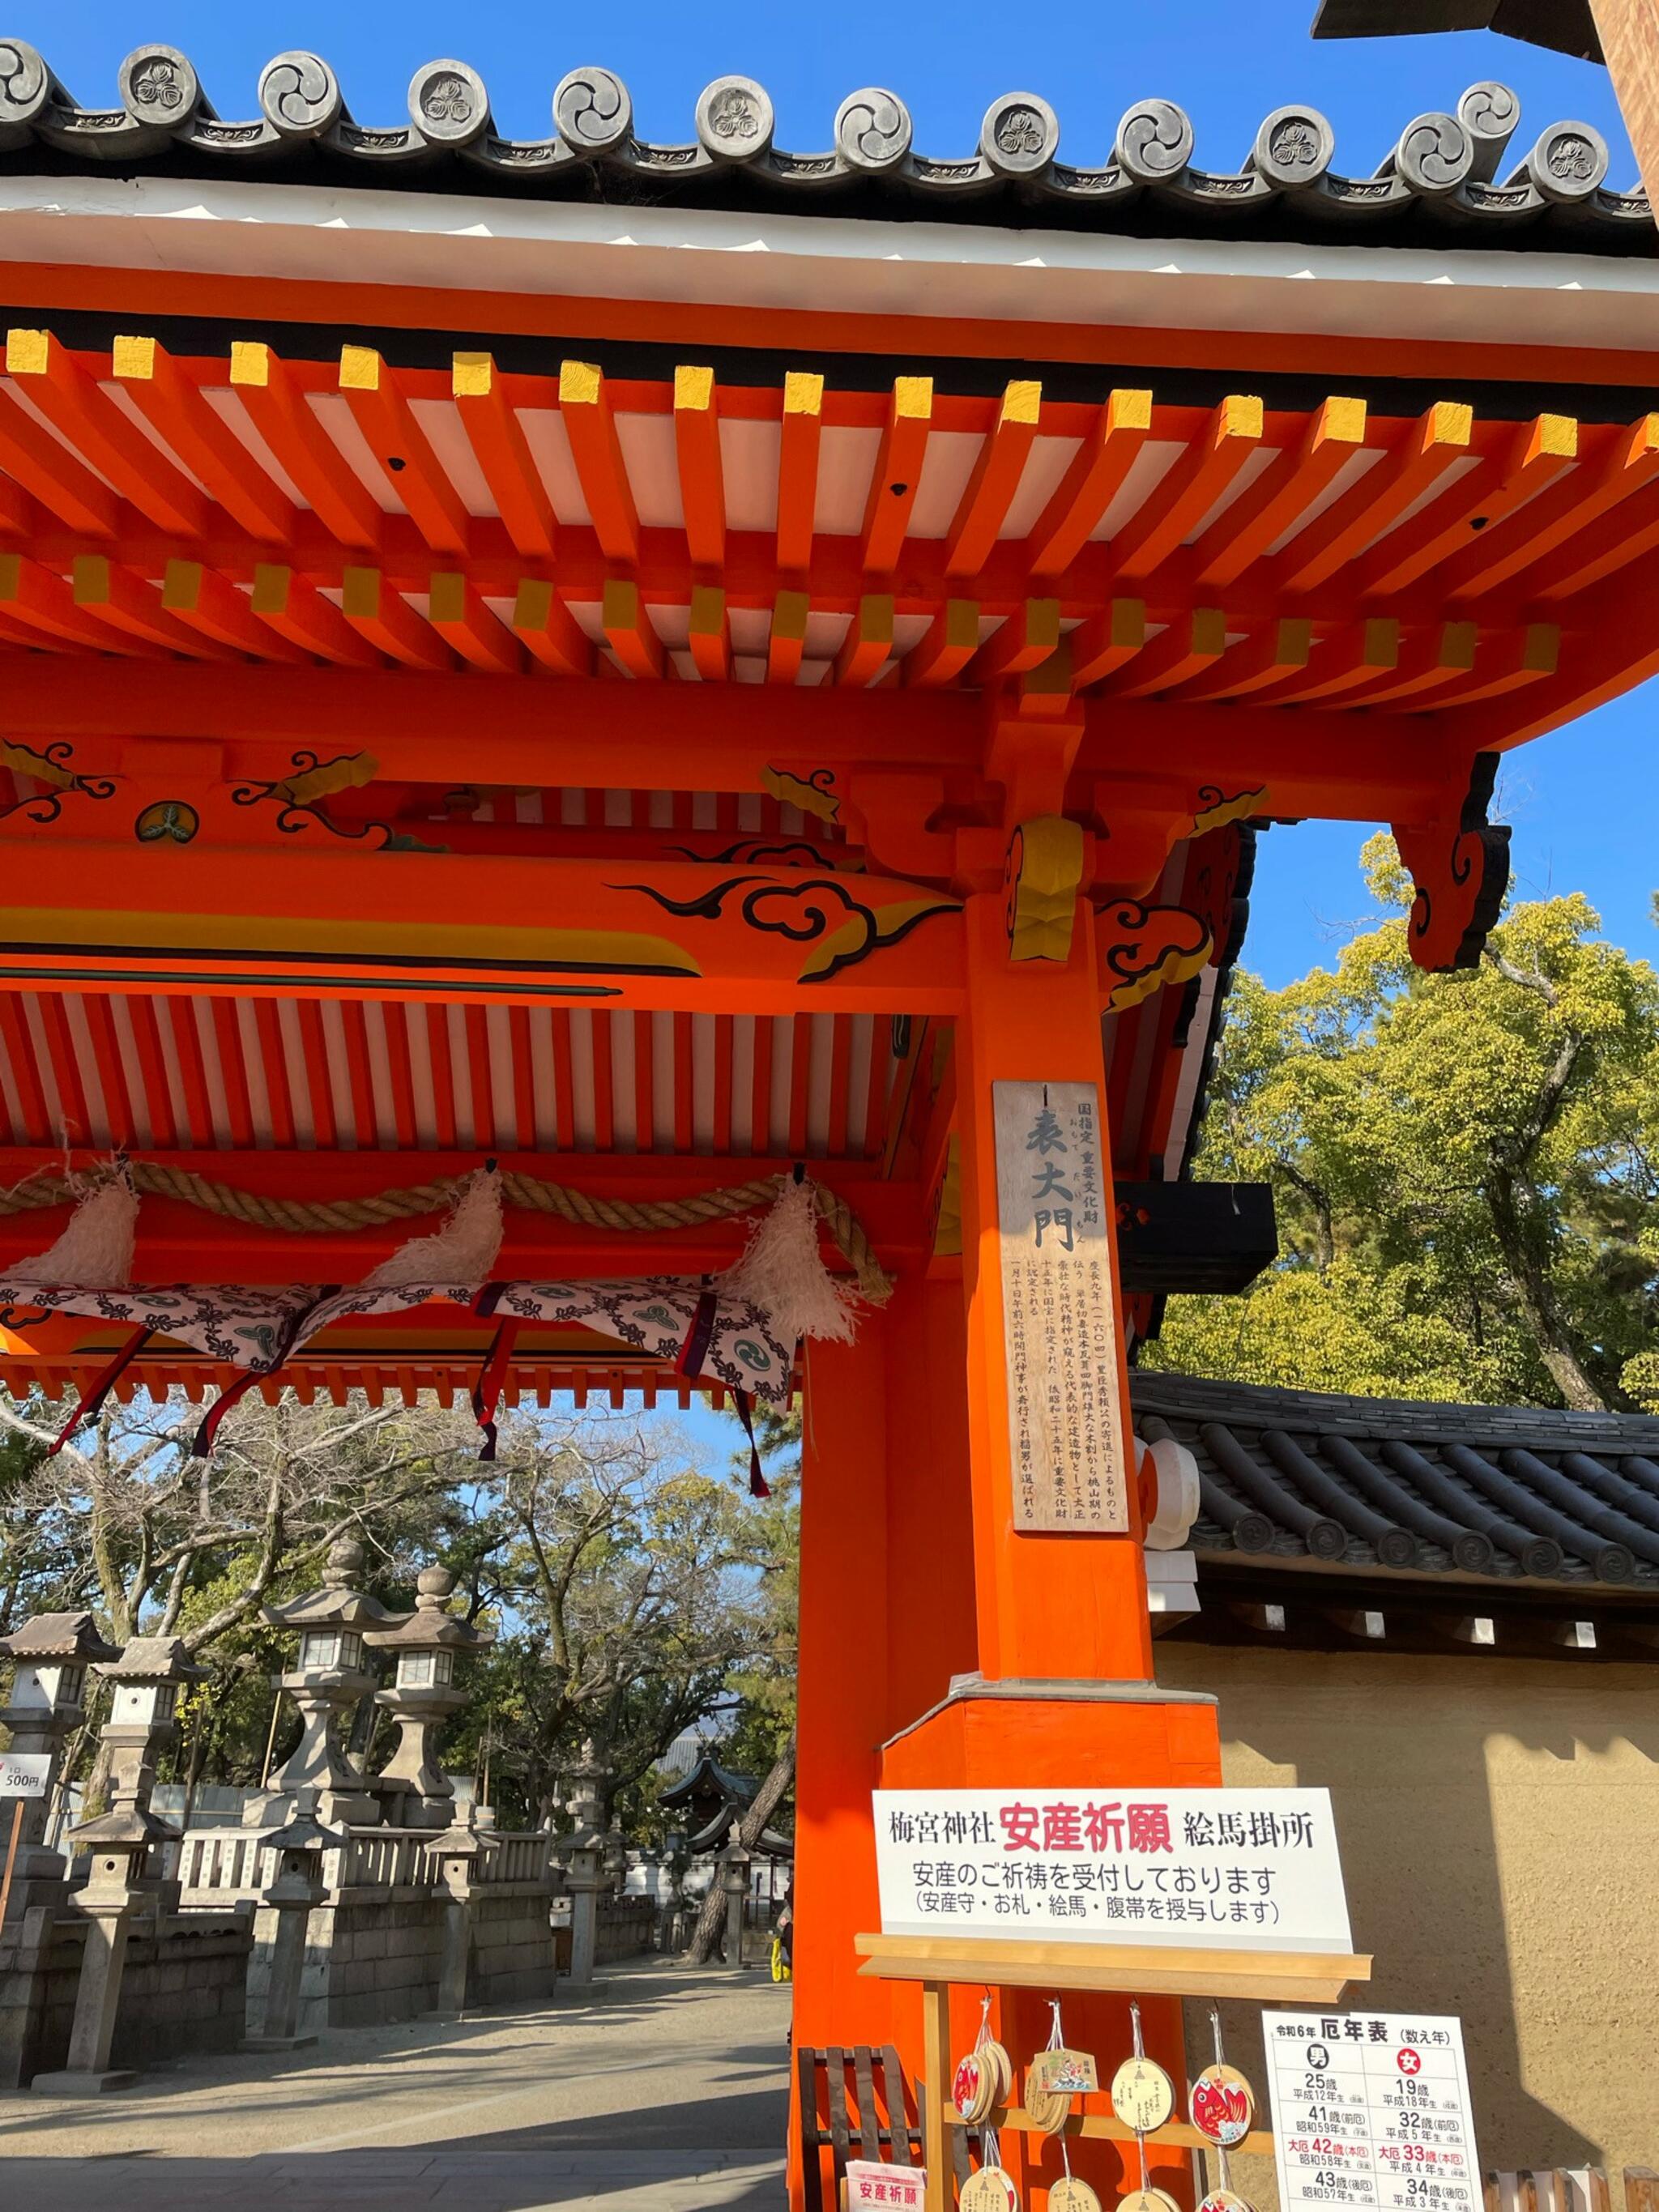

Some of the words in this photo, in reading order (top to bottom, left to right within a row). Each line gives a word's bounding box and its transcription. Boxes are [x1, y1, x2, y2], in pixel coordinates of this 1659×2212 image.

[1078, 1103, 1094, 1144] 国指定
[1026, 1109, 1075, 1251] 表大門
[1081, 1153, 1098, 1224] 重要文化財
[1026, 1260, 1039, 1316] に認定される
[6, 1775, 39, 1787] 500円
[888, 1810, 996, 1845] 梅宮神社
[1000, 1801, 1175, 1854] 安産祈願
[1183, 1810, 1315, 1849] 絵馬掛所
[912, 1860, 1277, 1895] 安産のご祈祷を受付しております
[1277, 2025, 1316, 2038] 令和6年
[1320, 2018, 1388, 2042] 厄年表
[1401, 2029, 1450, 2044] （数え年）
[1309, 2047, 1327, 2067] 男
[1400, 2052, 1418, 2071] 女
[1305, 2073, 1337, 2091] 25歳
[1397, 2079, 1429, 2096] 19歳
[1294, 2089, 1345, 2103] 平成12年生
[1383, 2095, 1437, 2109] 平成18年生
[1296, 2120, 1348, 2135] 昭和59年生
[1288, 2139, 1308, 2153] 大厄
[1379, 2146, 1401, 2160] 大厄
[1299, 2154, 1350, 2168] 昭和58年生
[860, 2182, 917, 2205] 安産祈願
[1303, 2186, 1355, 2202] 昭和57年生
